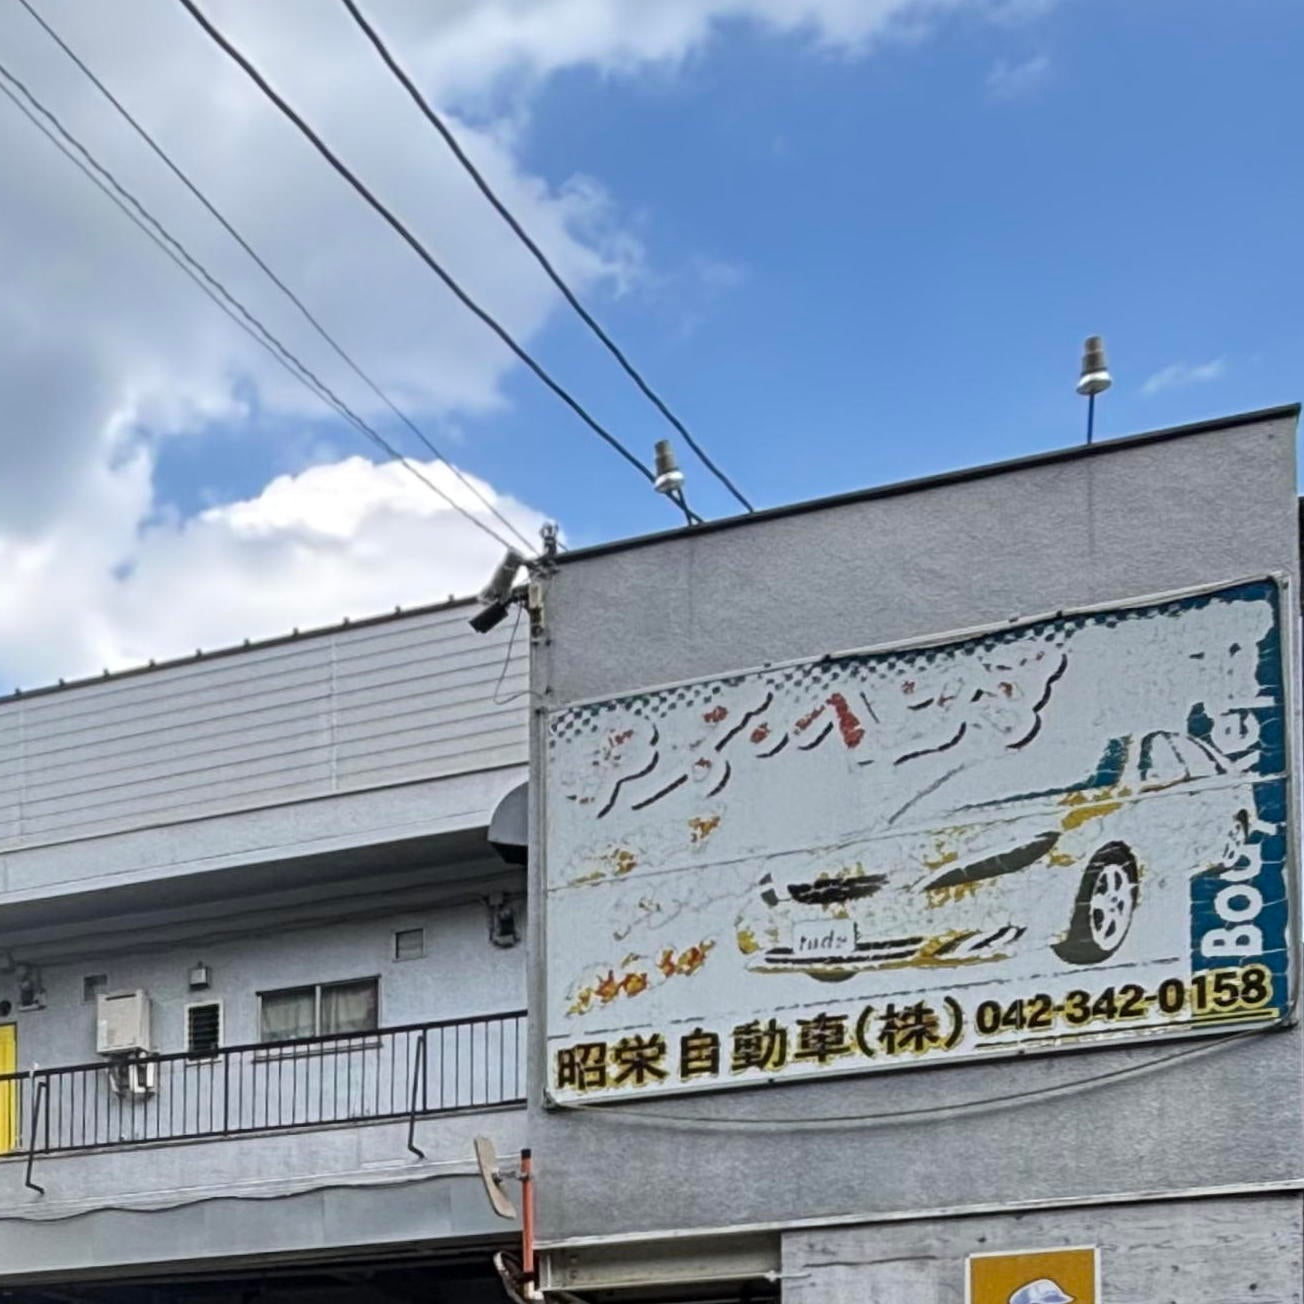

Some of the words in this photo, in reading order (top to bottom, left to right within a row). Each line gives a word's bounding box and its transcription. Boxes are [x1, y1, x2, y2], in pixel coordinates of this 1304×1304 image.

[557, 996, 963, 1091] 昭栄自動車(株)
[975, 967, 1268, 1035] 042-342-0158
